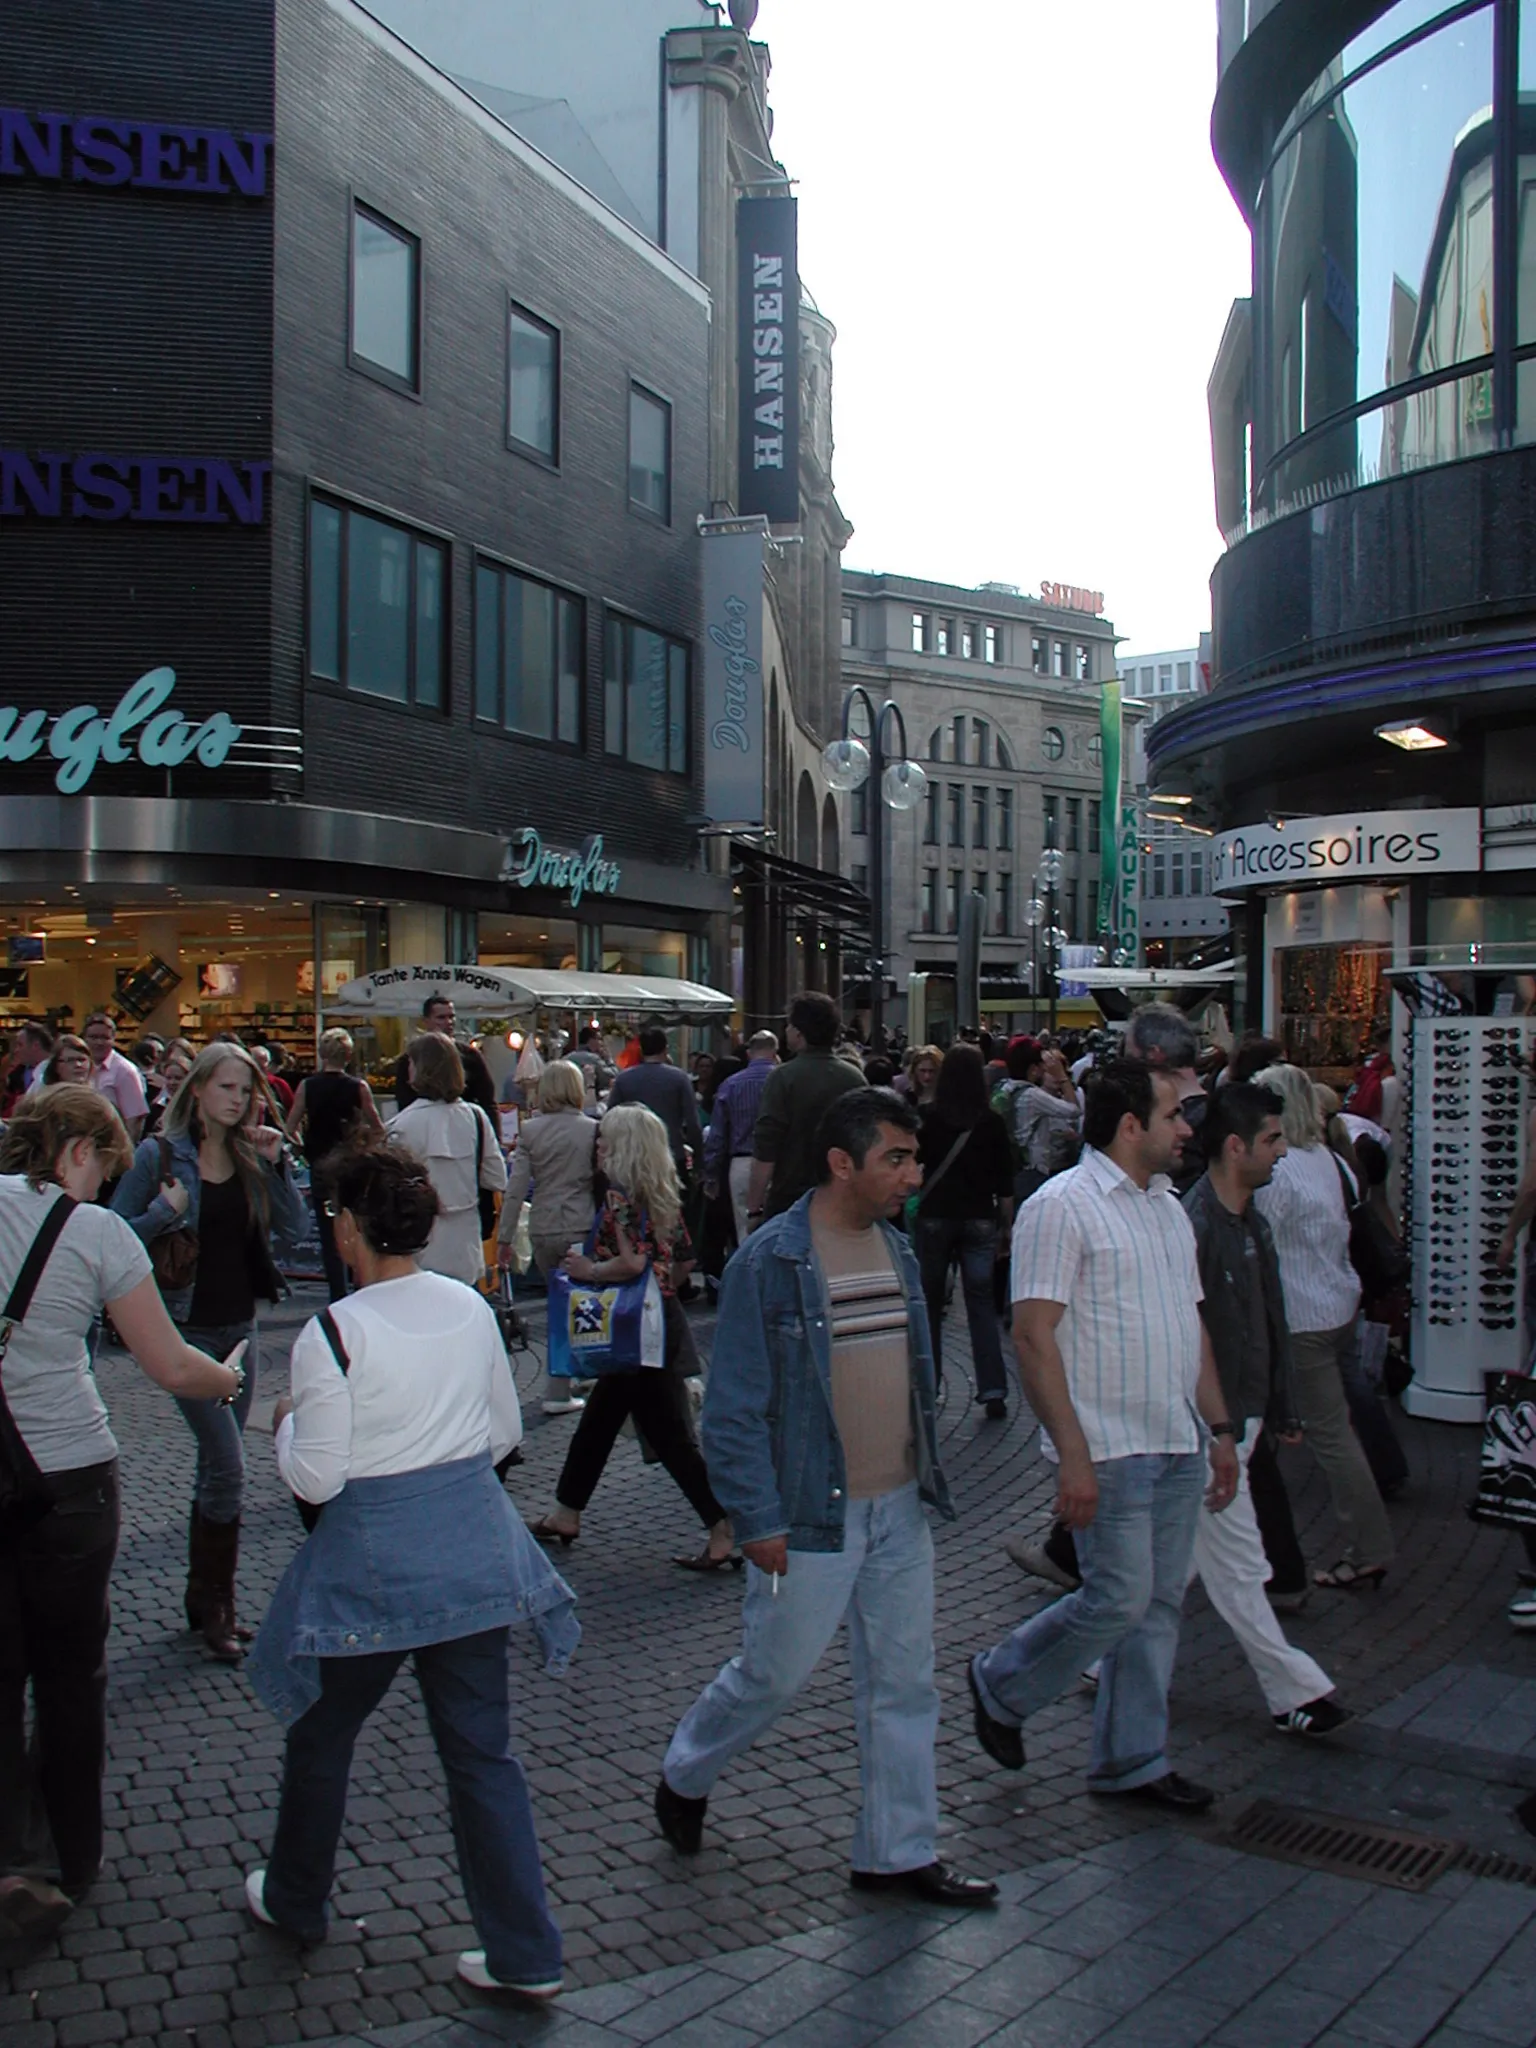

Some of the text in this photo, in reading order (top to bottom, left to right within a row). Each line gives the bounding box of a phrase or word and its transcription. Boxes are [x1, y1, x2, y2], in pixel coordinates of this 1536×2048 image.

[0, 107, 274, 196] NSEN
[753, 254, 784, 470] HANSEN
[0, 449, 272, 524] NSEN
[709, 594, 760, 754] Douglas
[0, 666, 242, 794] uglas
[500, 827, 621, 907] Douglas
[1232, 825, 1441, 877] Accessoires
[369, 969, 408, 988] Tante
[454, 967, 501, 993] Wagen
